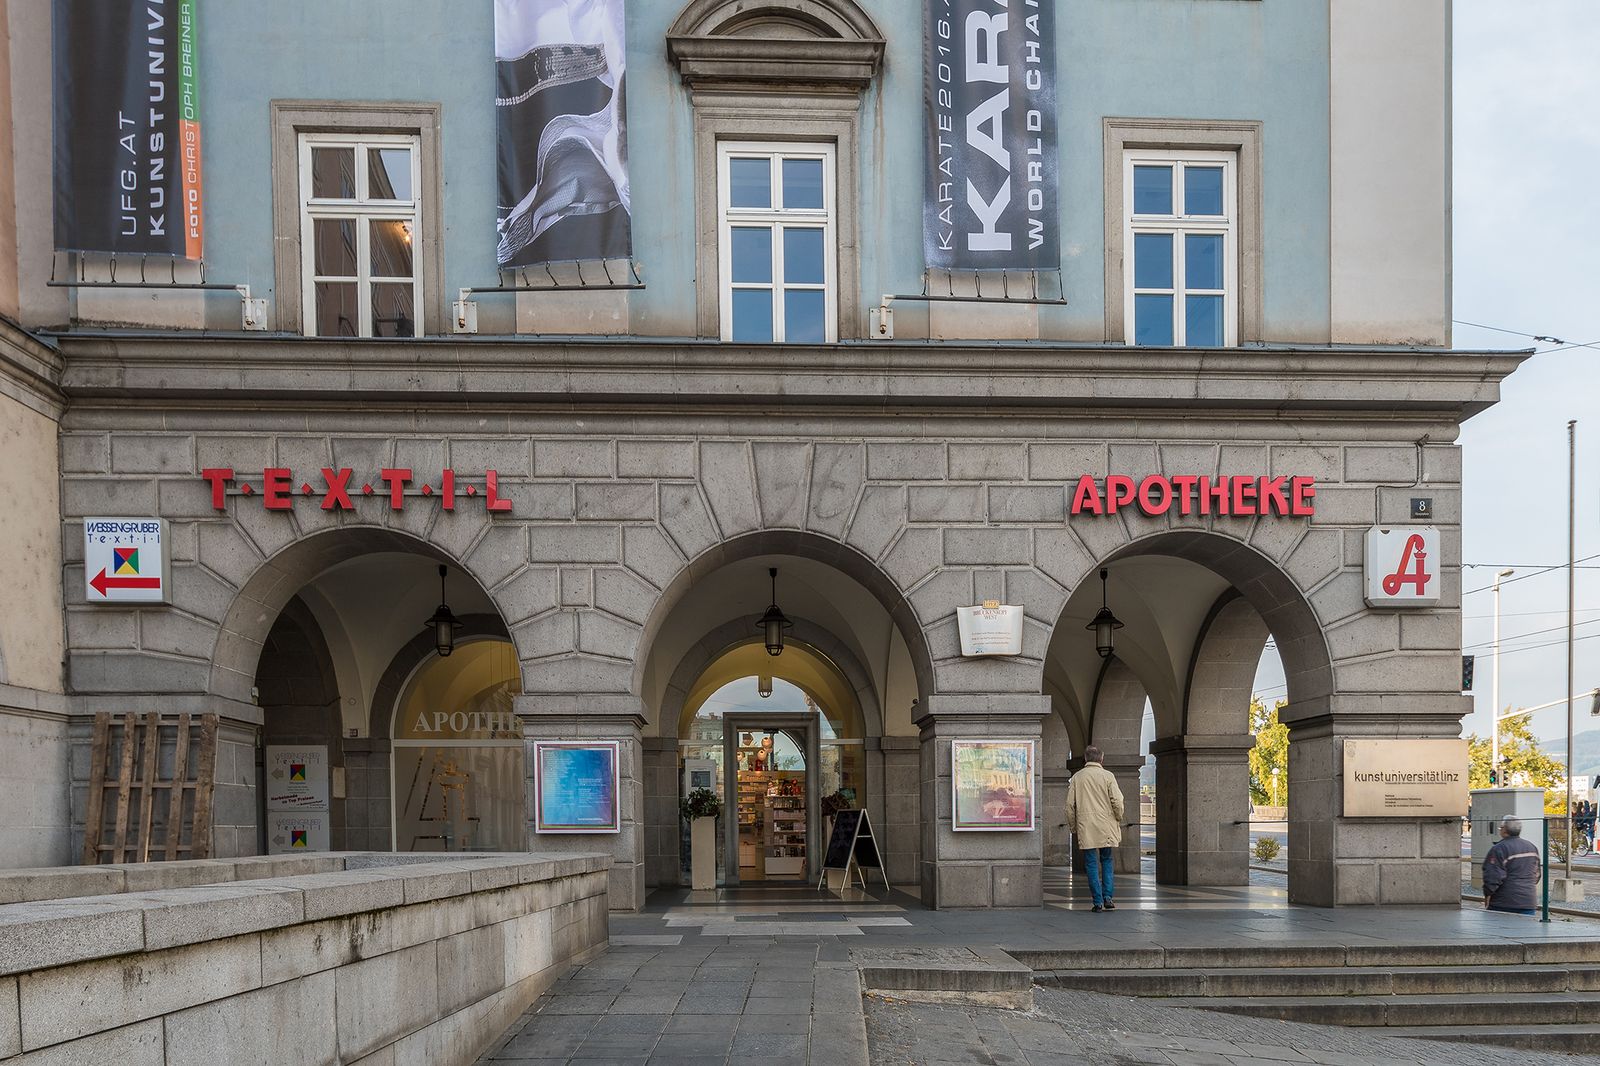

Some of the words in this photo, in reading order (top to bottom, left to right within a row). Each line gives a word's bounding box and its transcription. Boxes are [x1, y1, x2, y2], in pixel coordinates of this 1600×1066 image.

[181, 3, 192, 77] BREINER
[147, 0, 165, 236] KUNSTUNIV
[184, 82, 197, 184] CHRISTOPH
[965, 0, 1012, 250] KAR
[119, 110, 137, 235] UFG.AT
[188, 189, 199, 238] FOTO
[1026, 109, 1044, 250] WORLD
[1070, 474, 1316, 517] APOTHEKE
[1419, 500, 1426, 512] 8
